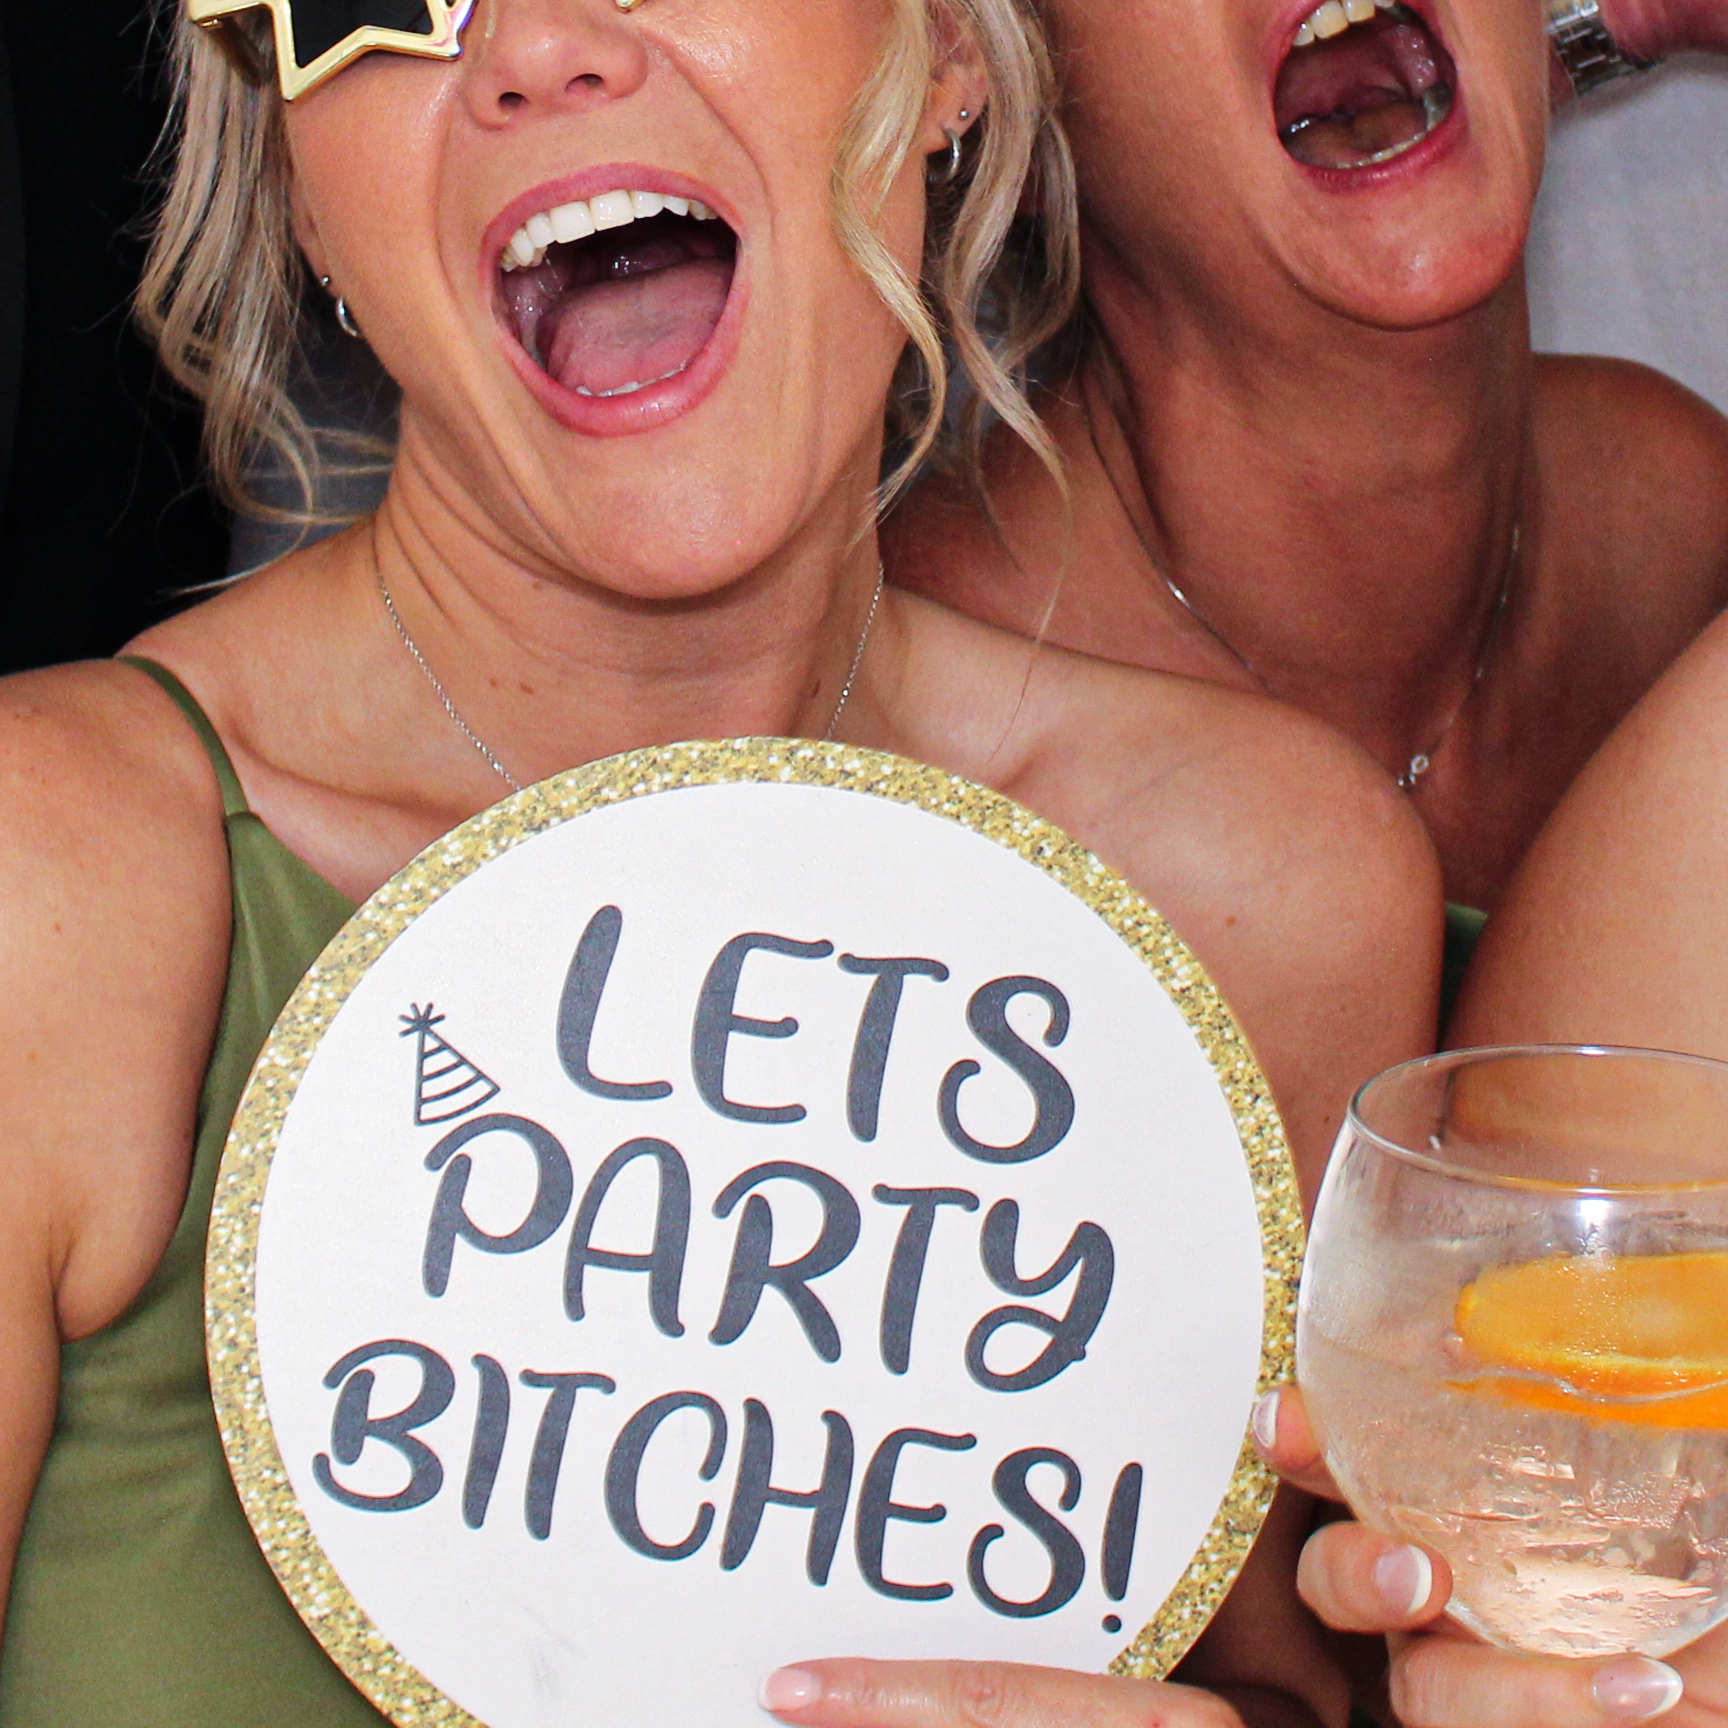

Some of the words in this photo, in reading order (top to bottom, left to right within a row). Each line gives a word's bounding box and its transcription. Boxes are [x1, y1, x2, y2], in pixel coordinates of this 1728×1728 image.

[556, 905, 1075, 1163] LETS
[422, 1113, 1115, 1392] PARTY
[313, 1338, 1143, 1632] BITCHES!
